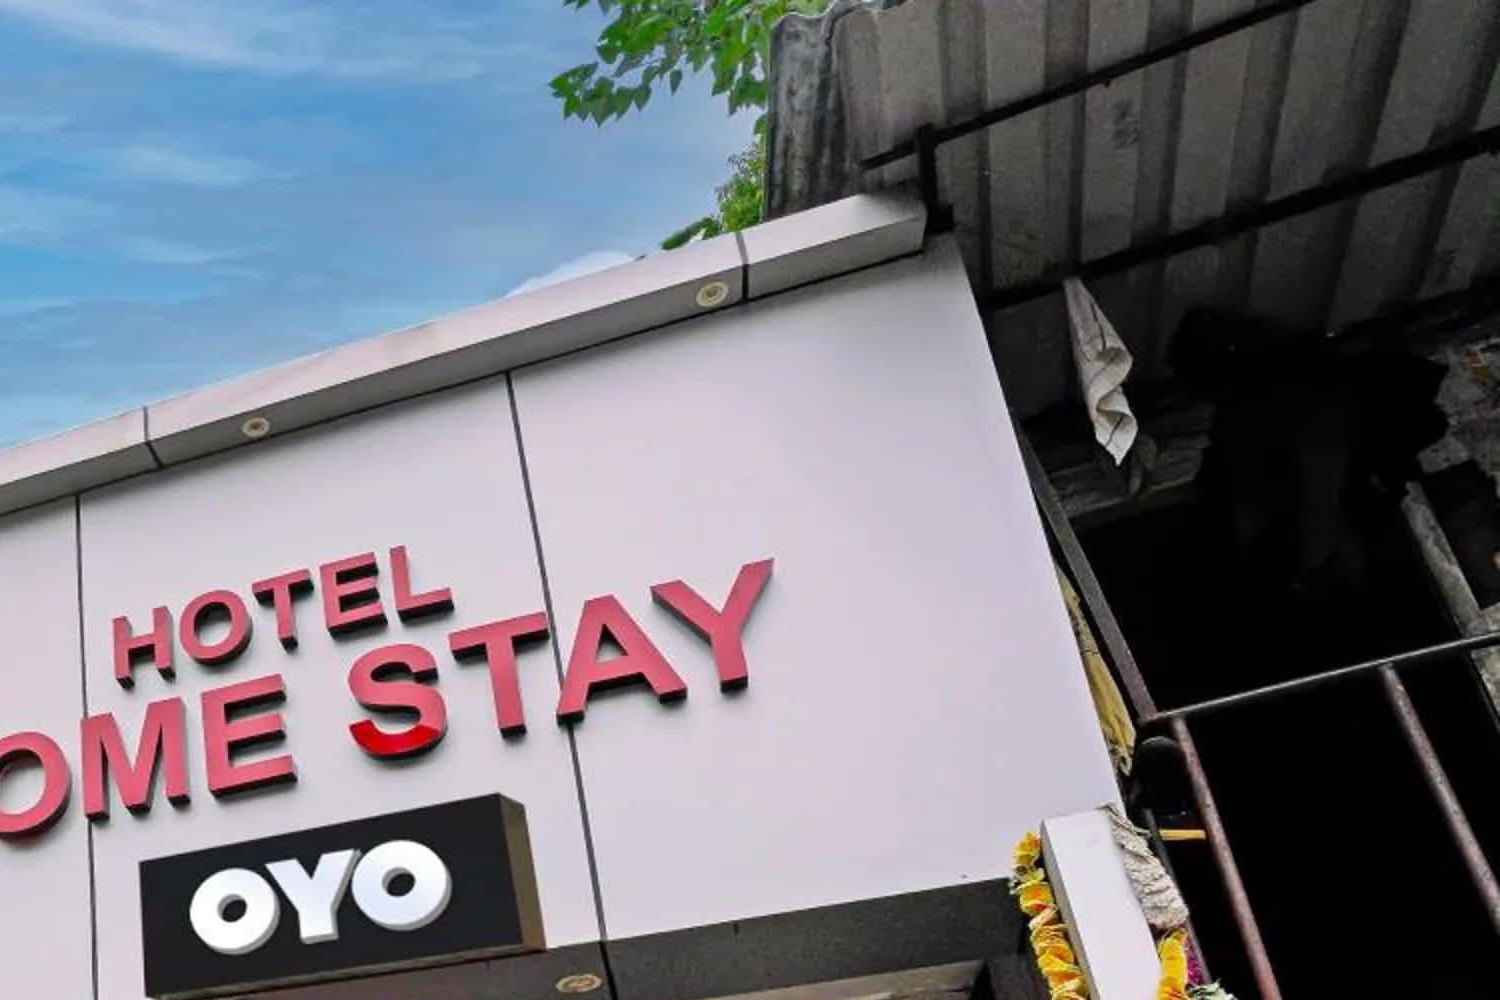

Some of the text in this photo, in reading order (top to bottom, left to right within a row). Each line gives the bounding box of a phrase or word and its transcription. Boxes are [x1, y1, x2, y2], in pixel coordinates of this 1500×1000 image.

[113, 545, 455, 688] HOTEL
[347, 557, 776, 761] STAY
[188, 838, 452, 955] OYO
